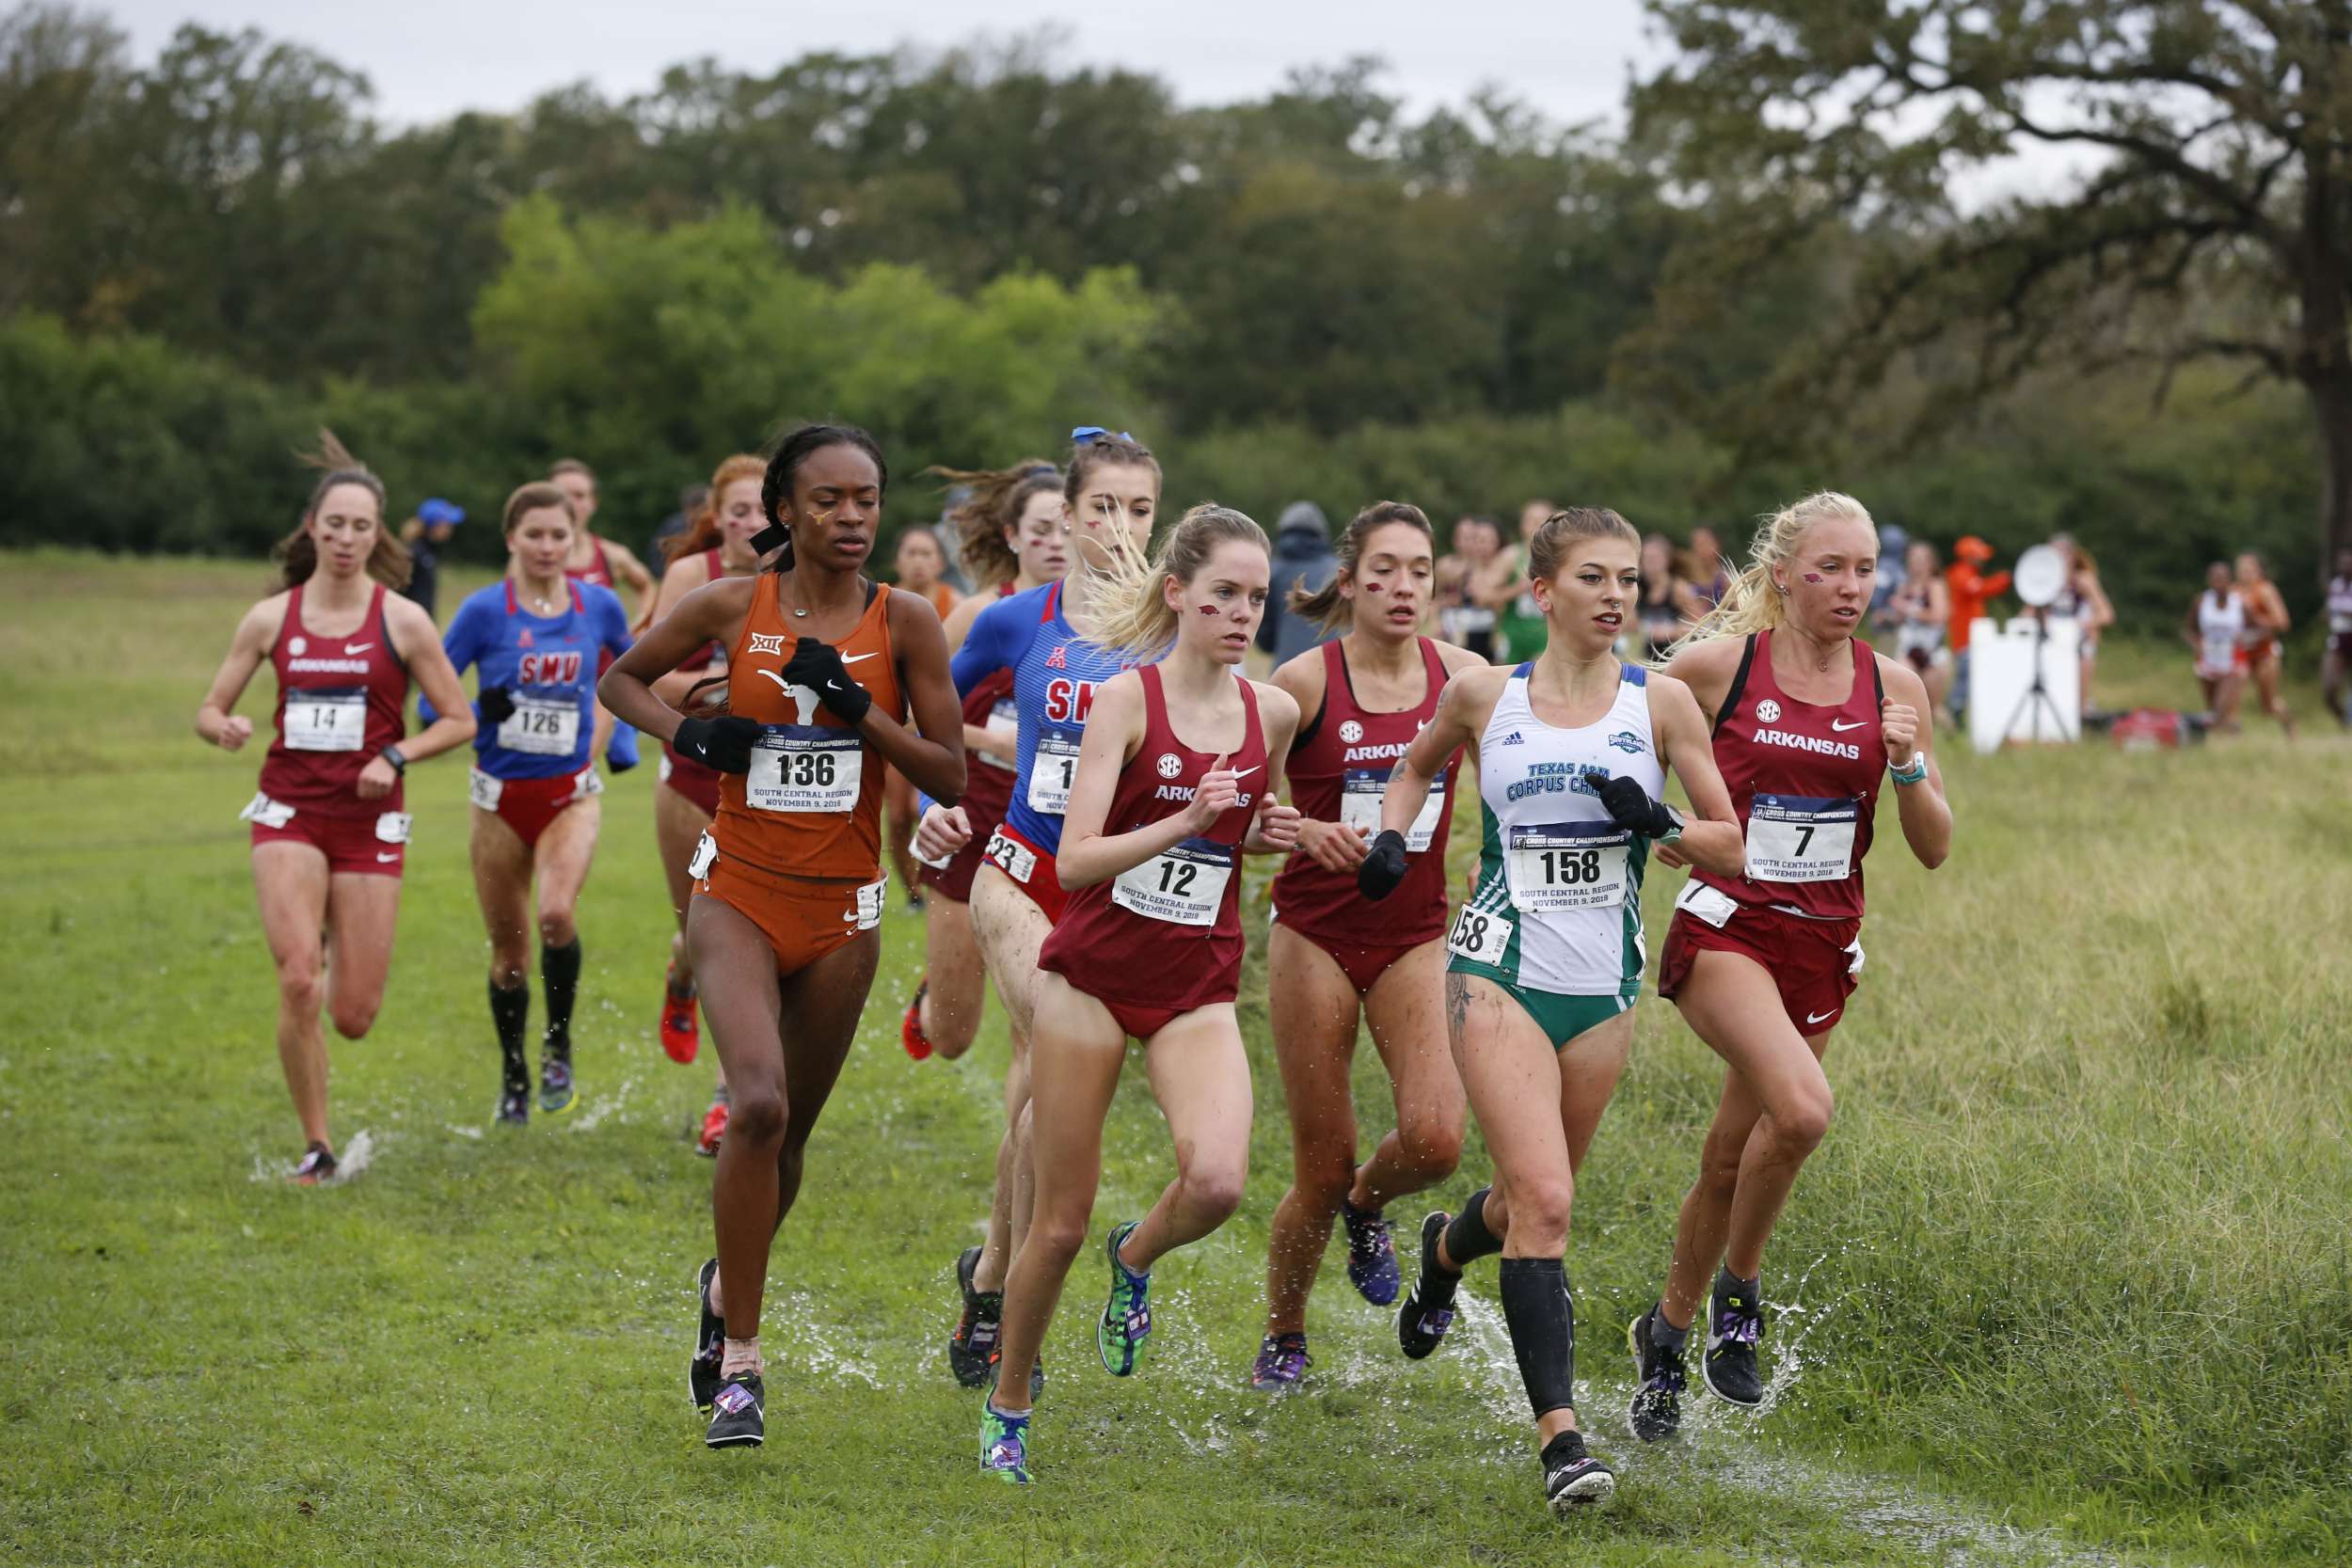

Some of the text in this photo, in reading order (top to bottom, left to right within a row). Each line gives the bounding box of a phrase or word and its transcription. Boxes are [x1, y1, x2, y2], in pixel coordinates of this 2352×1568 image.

[517, 651, 582, 687] SMU
[1045, 677, 1099, 724] SM
[1757, 701, 1779, 721] SEC
[313, 707, 336, 730] 14
[522, 712, 561, 735] 126
[767, 737, 785, 746] CROSS
[785, 739, 811, 748] COUNTRY
[812, 739, 860, 748] CHAMPIONSHIPS
[1343, 742, 1411, 763] ARKAN
[1753, 728, 1860, 760] ARKANSAS
[777, 753, 835, 786] 136
[1159, 755, 1181, 778] SEC
[1528, 762, 1611, 780] TEXAS A&M
[1037, 791, 1062, 800] SOUTH
[1506, 776, 1566, 802] CORPUS
[1766, 809, 1786, 817] CROSS
[1576, 835, 1625, 844] CHAMPIONSHIPS
[1794, 826, 1814, 857] 7
[1159, 861, 1197, 896] 12
[1540, 850, 1600, 884] 158
[1764, 869, 1806, 878] NOVEMBER
[1121, 885, 1212, 911] SOUTH CENTRAL REGION
[1592, 883, 1619, 894] REGION
[1129, 898, 1172, 916] NOVEMBER
[1533, 898, 1579, 907] NOVEMBER
[1591, 895, 1609, 903] 2018
